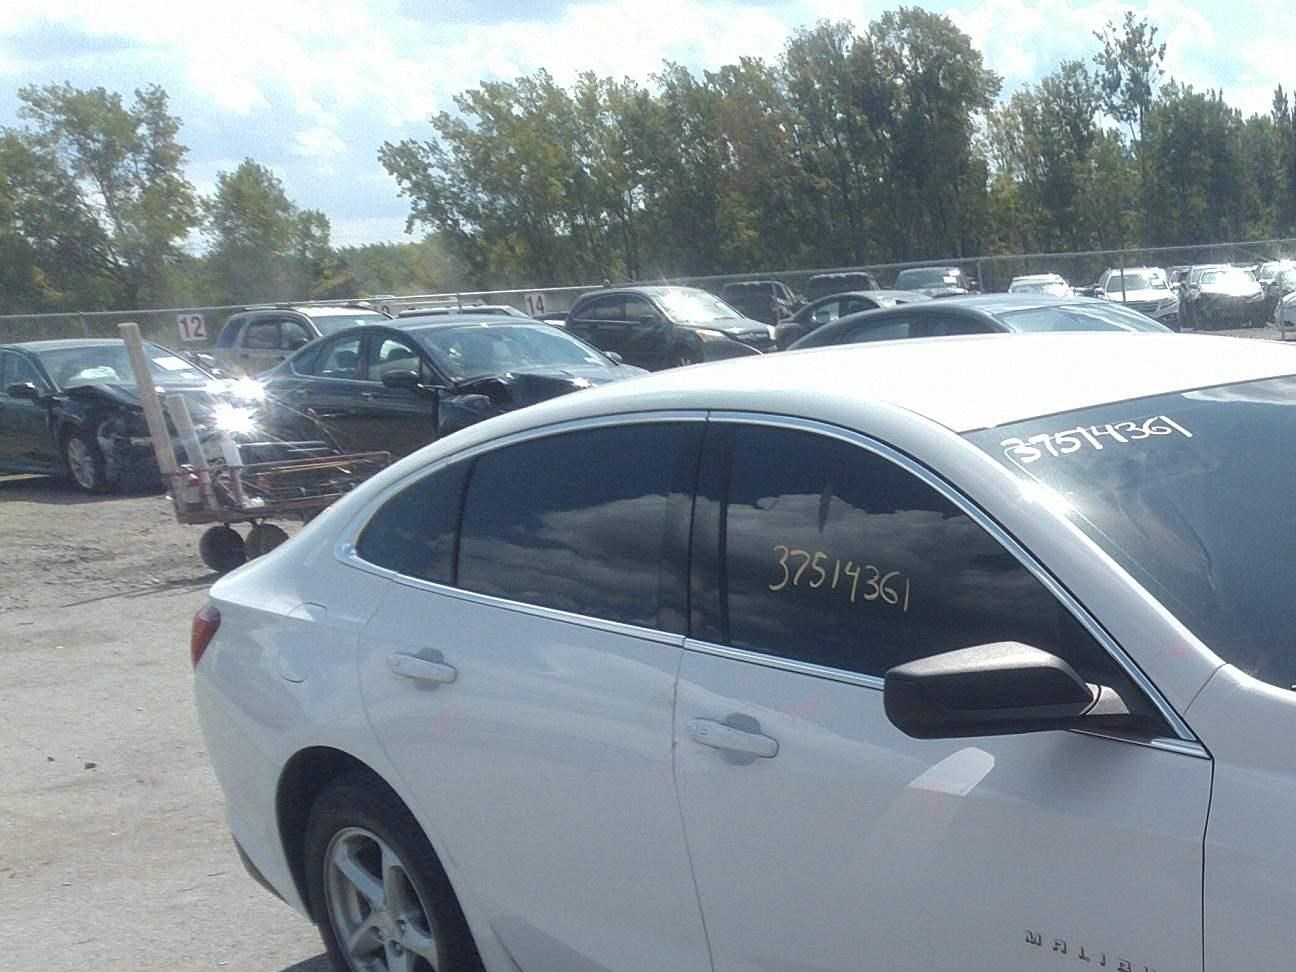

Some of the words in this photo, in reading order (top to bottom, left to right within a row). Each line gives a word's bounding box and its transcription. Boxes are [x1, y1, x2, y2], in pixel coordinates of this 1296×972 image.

[527, 295, 545, 315] 14
[180, 316, 204, 338] 12
[1001, 415, 1193, 463] 37514361
[768, 545, 910, 612] 37514361
